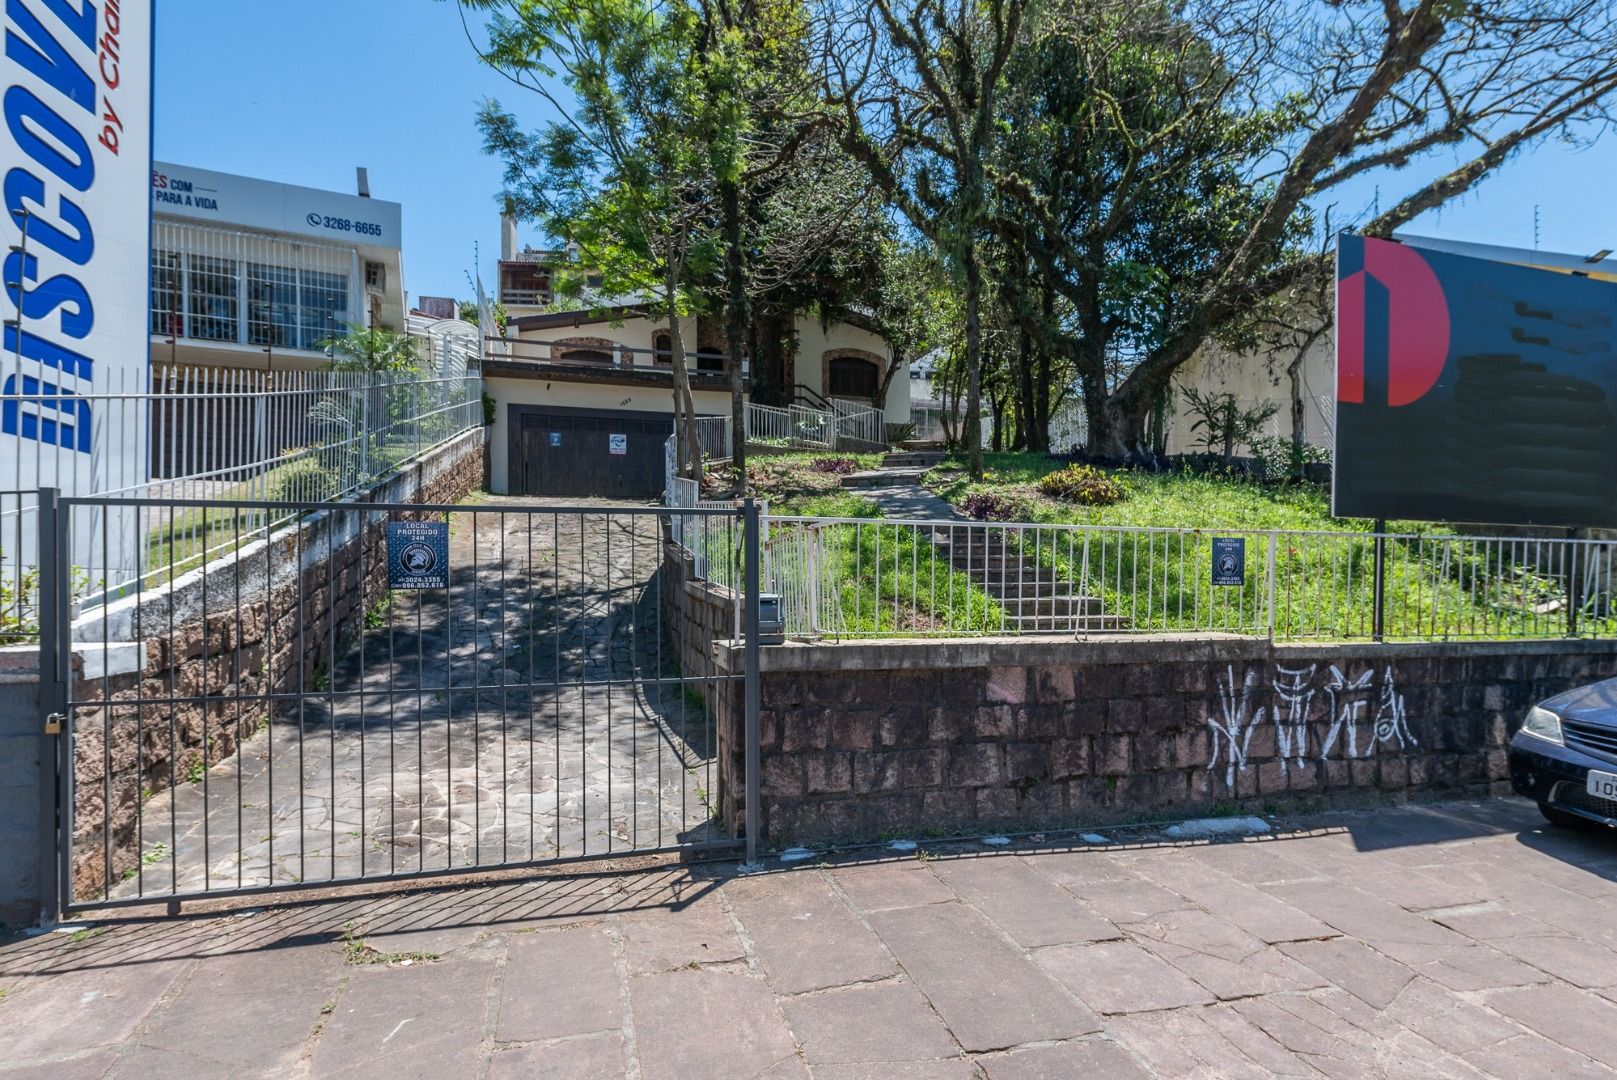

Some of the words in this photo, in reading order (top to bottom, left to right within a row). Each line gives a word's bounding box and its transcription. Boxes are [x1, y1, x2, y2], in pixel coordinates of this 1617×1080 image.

[99, 0, 121, 90] Cha
[98, 95, 124, 157] by
[170, 179, 193, 192] COM
[156, 190, 183, 205] PARA
[185, 195, 192, 206] A
[194, 196, 218, 210] VIDA
[323, 216, 382, 236] 3268-6655
